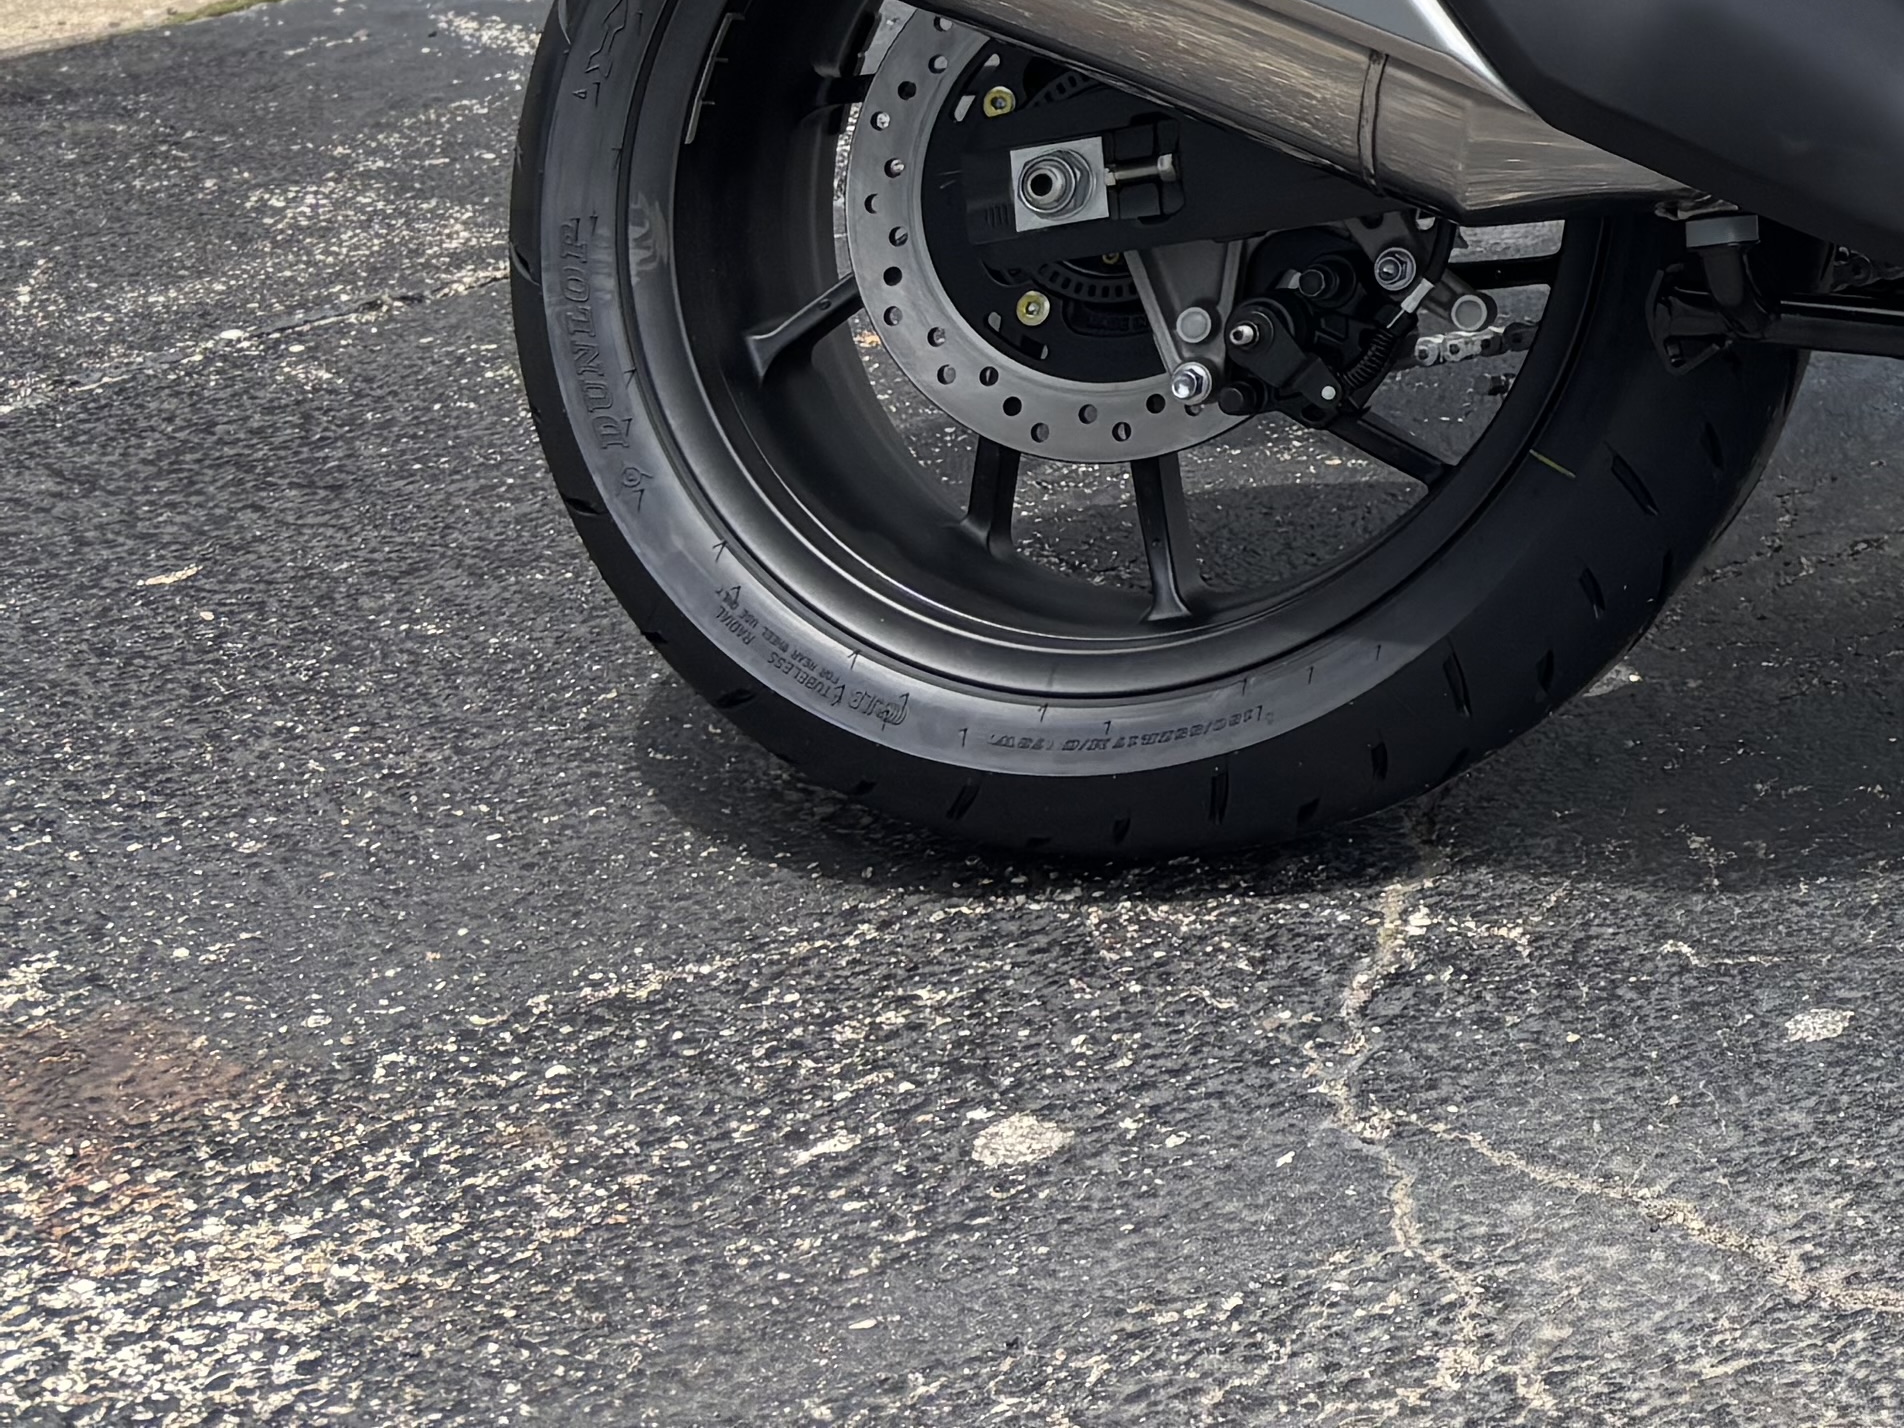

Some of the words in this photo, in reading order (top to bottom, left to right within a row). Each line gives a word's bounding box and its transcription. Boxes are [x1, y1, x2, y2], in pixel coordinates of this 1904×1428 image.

[558, 220, 631, 450] DUNLOP
[714, 606, 757, 646] RADIAL
[761, 625, 791, 654] WHEEL
[767, 651, 834, 699] TUBELESS
[790, 649, 818, 673] REAR
[819, 667, 841, 686] FOR
